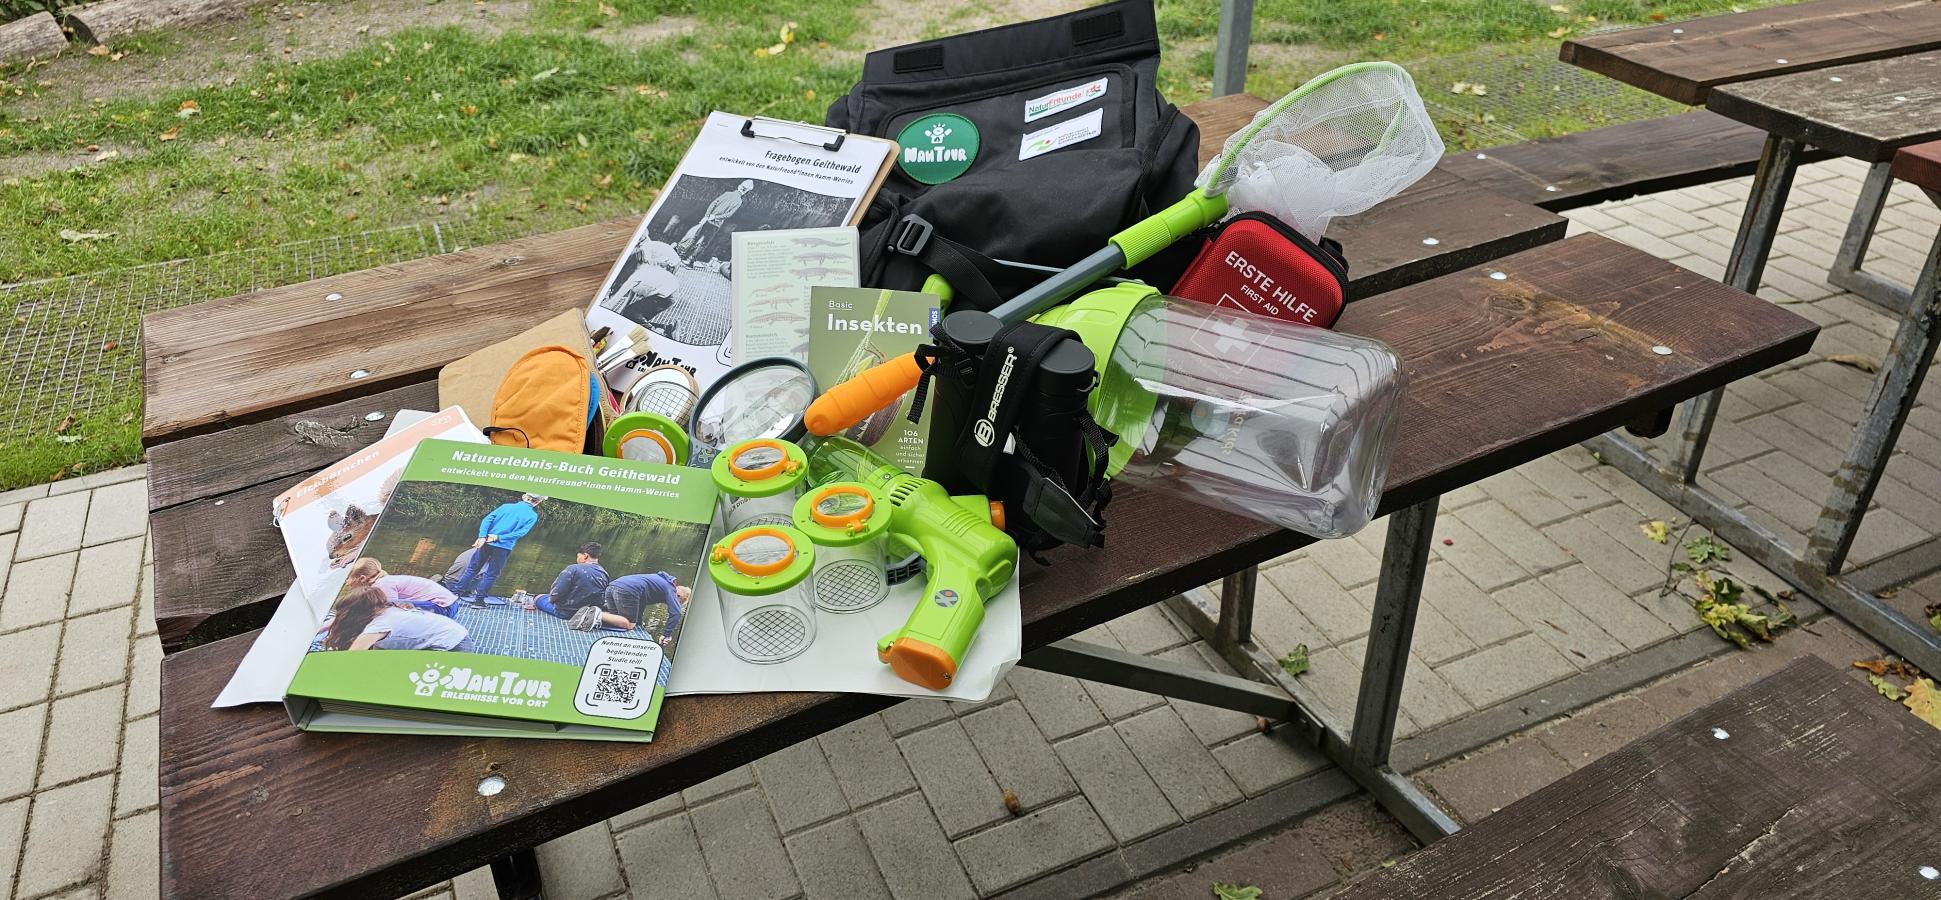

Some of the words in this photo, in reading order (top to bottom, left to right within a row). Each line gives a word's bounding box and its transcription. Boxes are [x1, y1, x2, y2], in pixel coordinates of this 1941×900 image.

[719, 156, 746, 166] entwickelt
[764, 150, 811, 166] Fragebogen
[812, 158, 862, 174] Geithewald
[1225, 250, 1274, 292] ERSTE
[1272, 286, 1317, 322] HILFE
[828, 300, 853, 309] Basic
[1240, 284, 1265, 304] FIRST
[1262, 302, 1279, 315] AID
[827, 313, 922, 335] Insekten
[897, 436, 924, 444] ARTEN
[452, 450, 594, 475] Naturerlebnis-Buch
[598, 466, 681, 485] Geithewald
[441, 466, 489, 477] entwickelt
[508, 473, 526, 481] den
[614, 484, 680, 498] Hamm-Werries
[606, 648, 648, 657] begleitenden
[608, 656, 628, 664] Studie
[441, 690, 501, 703] ERLEBNISSE
[502, 696, 524, 706] VOR
[526, 699, 549, 708] ORT
